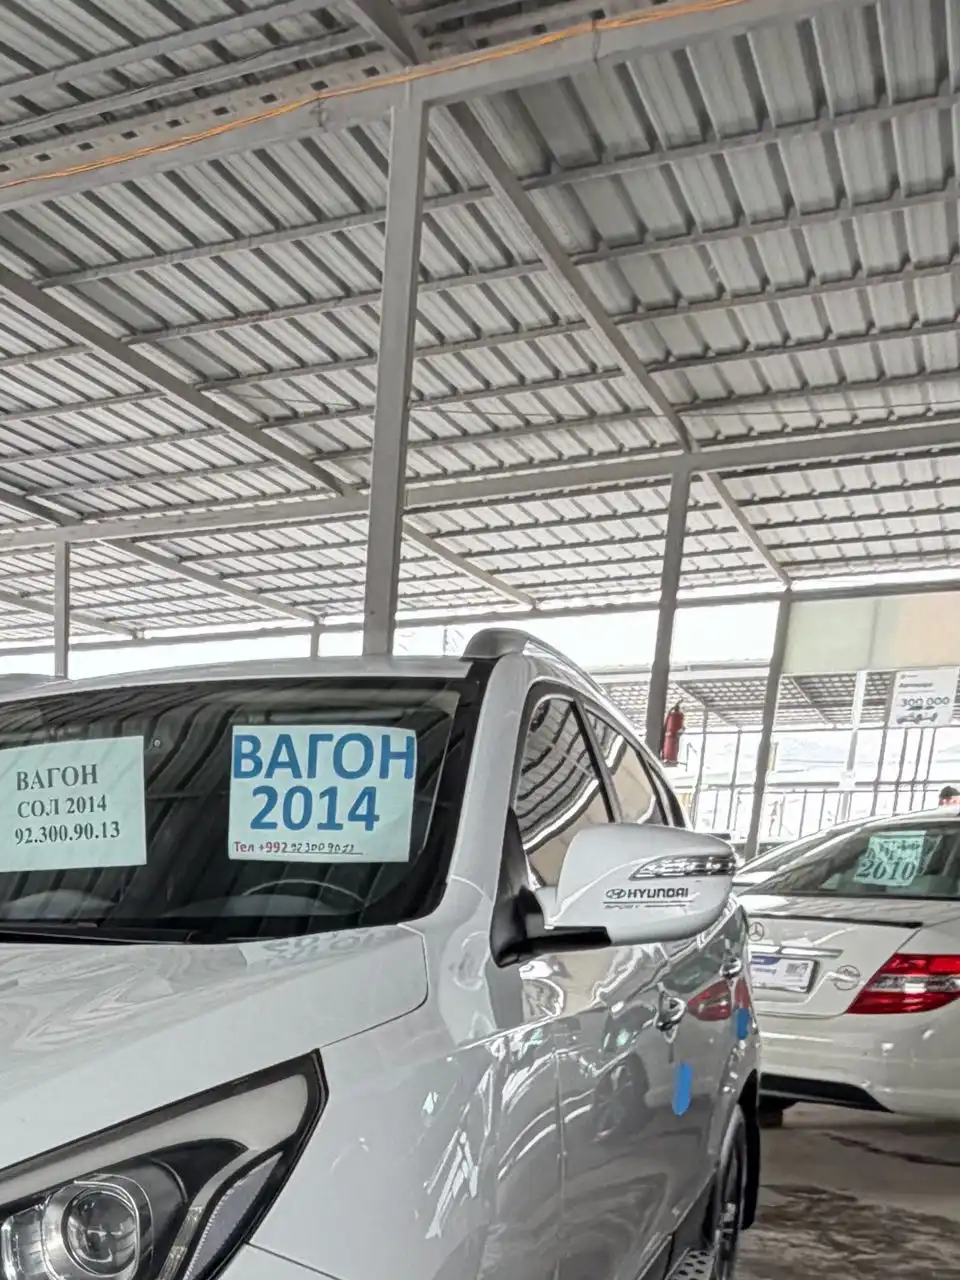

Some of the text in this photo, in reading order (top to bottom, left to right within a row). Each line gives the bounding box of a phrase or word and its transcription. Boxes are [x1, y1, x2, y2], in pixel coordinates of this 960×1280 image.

[233, 733, 415, 779] ВАГОН
[16, 763, 99, 791] ВАГОН
[17, 794, 107, 819] СОЛ 2014
[250, 785, 380, 831] 2014
[15, 820, 120, 845] 92.300.90.13
[234, 841, 254, 853] Тел
[855, 859, 916, 880] 2010
[627, 887, 689, 899] HYUNDAI
